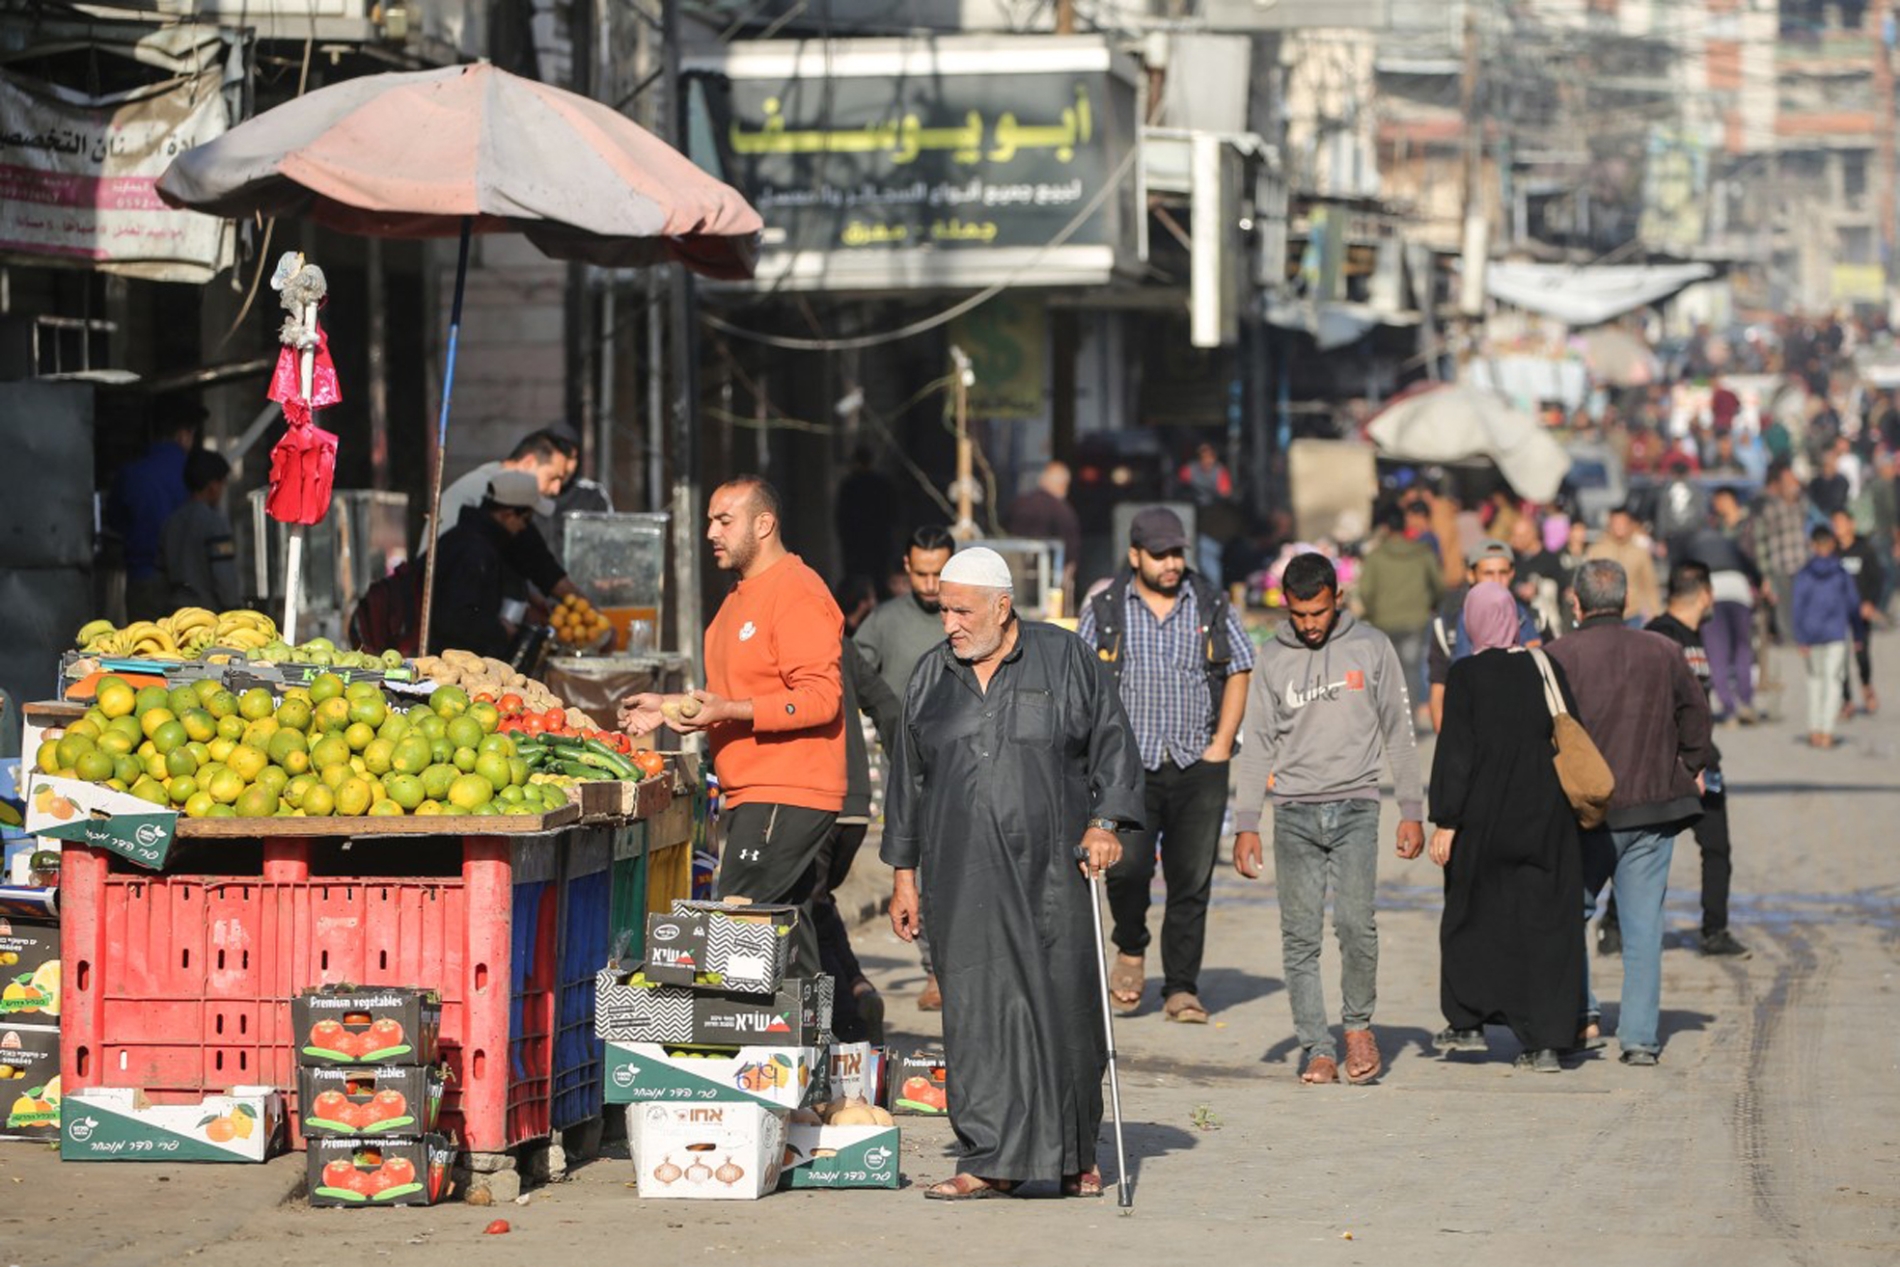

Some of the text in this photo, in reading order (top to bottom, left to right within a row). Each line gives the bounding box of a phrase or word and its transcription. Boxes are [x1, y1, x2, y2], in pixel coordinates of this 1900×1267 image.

[729, 97, 983, 164] يوسف
[111, 838, 135, 852] הדר
[138, 848, 160, 860] פרי
[309, 995, 403, 1010] Premium vegetables
[735, 1010, 770, 1031] שיא
[903, 1057, 936, 1067] Premium
[669, 1087, 693, 1098] הדר
[696, 1087, 718, 1099] פרי
[129, 1140, 154, 1151] הדר
[157, 1140, 180, 1151] פרי
[320, 1138, 362, 1149] Premium
[843, 1170, 867, 1181] הדר
[871, 1170, 892, 1182] פרי
